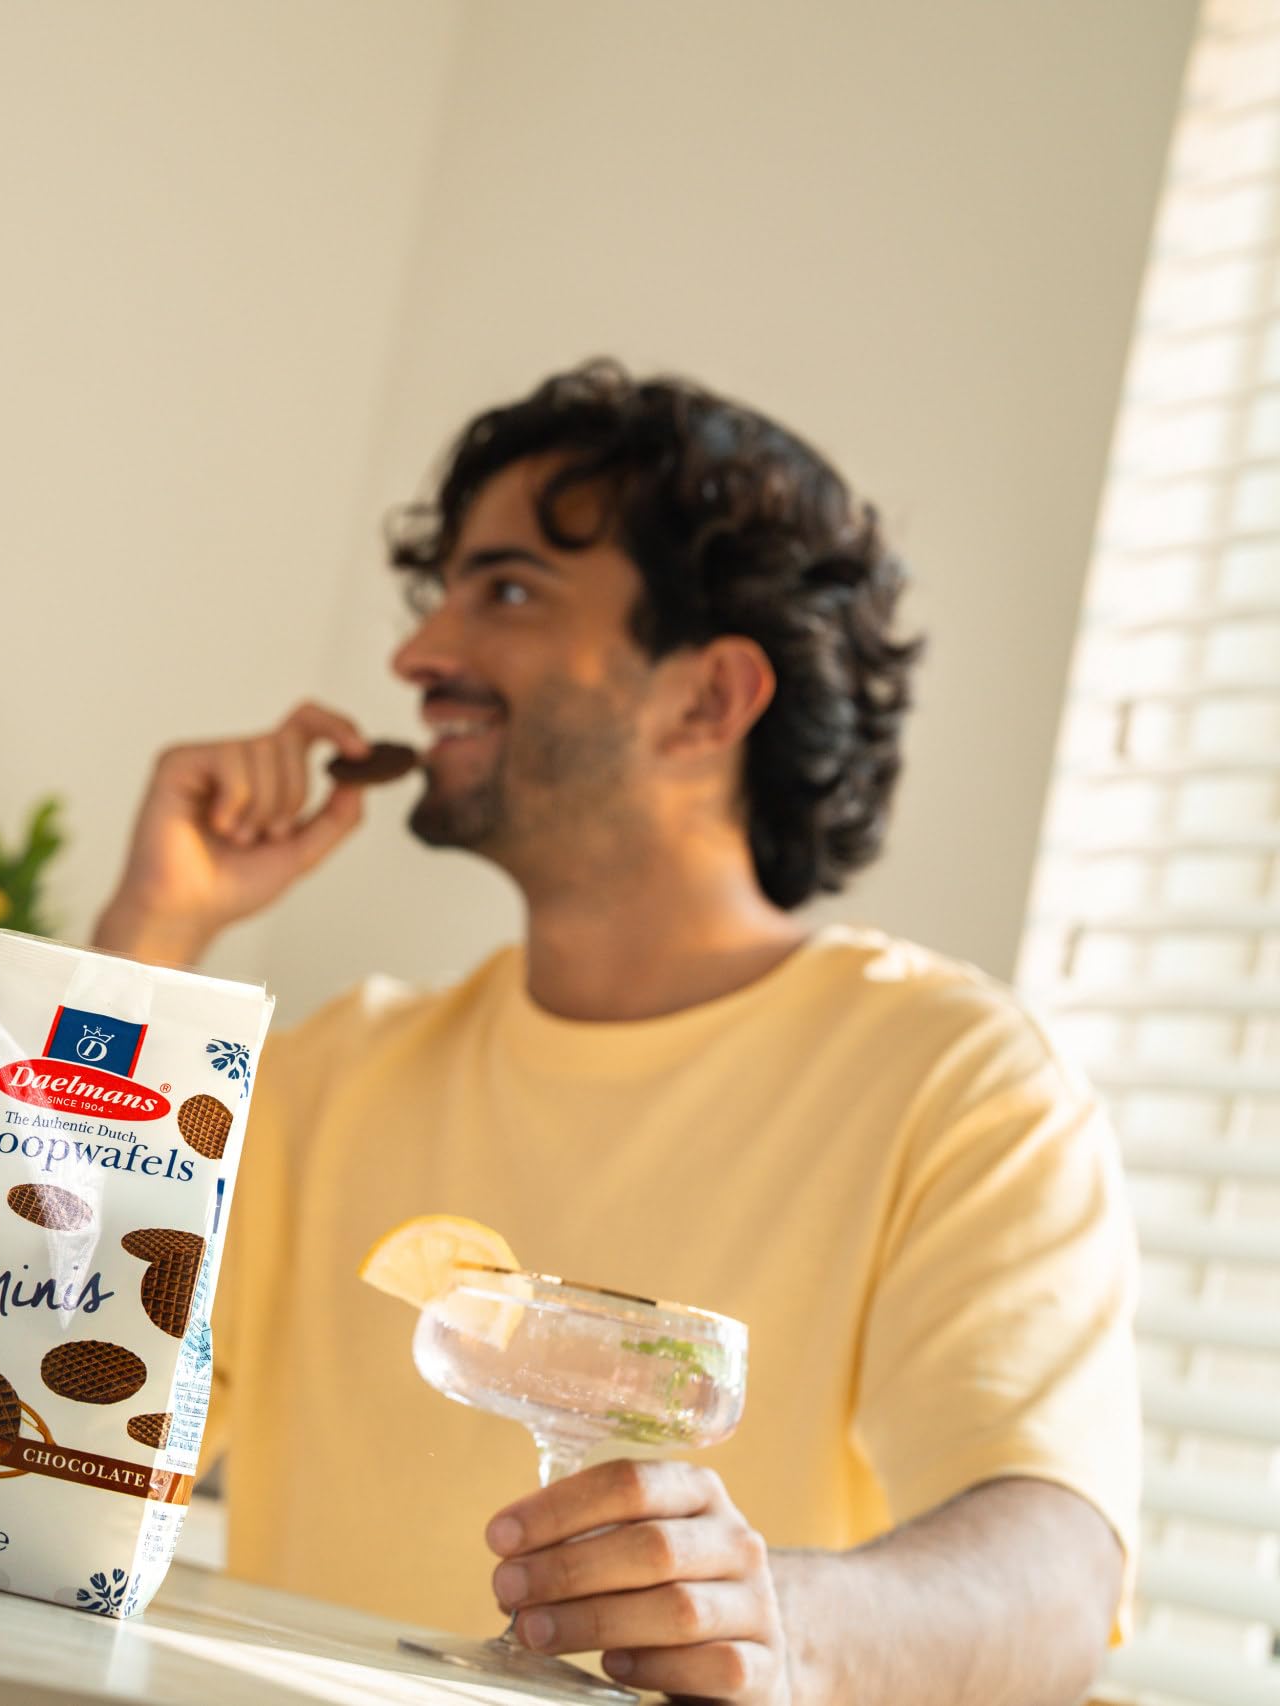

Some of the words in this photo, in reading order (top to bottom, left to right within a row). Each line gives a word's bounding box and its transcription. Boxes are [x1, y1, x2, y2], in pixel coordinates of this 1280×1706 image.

[8, 1065, 158, 1112] Daelmans
[46, 1095, 77, 1108] SINCE
[80, 1101, 105, 1113] 1904
[5, 1110, 29, 1126] The
[31, 1115, 94, 1135] Authentic
[96, 1124, 137, 1144] Dutch
[22, 1447, 146, 1488] CHOCOLATE
